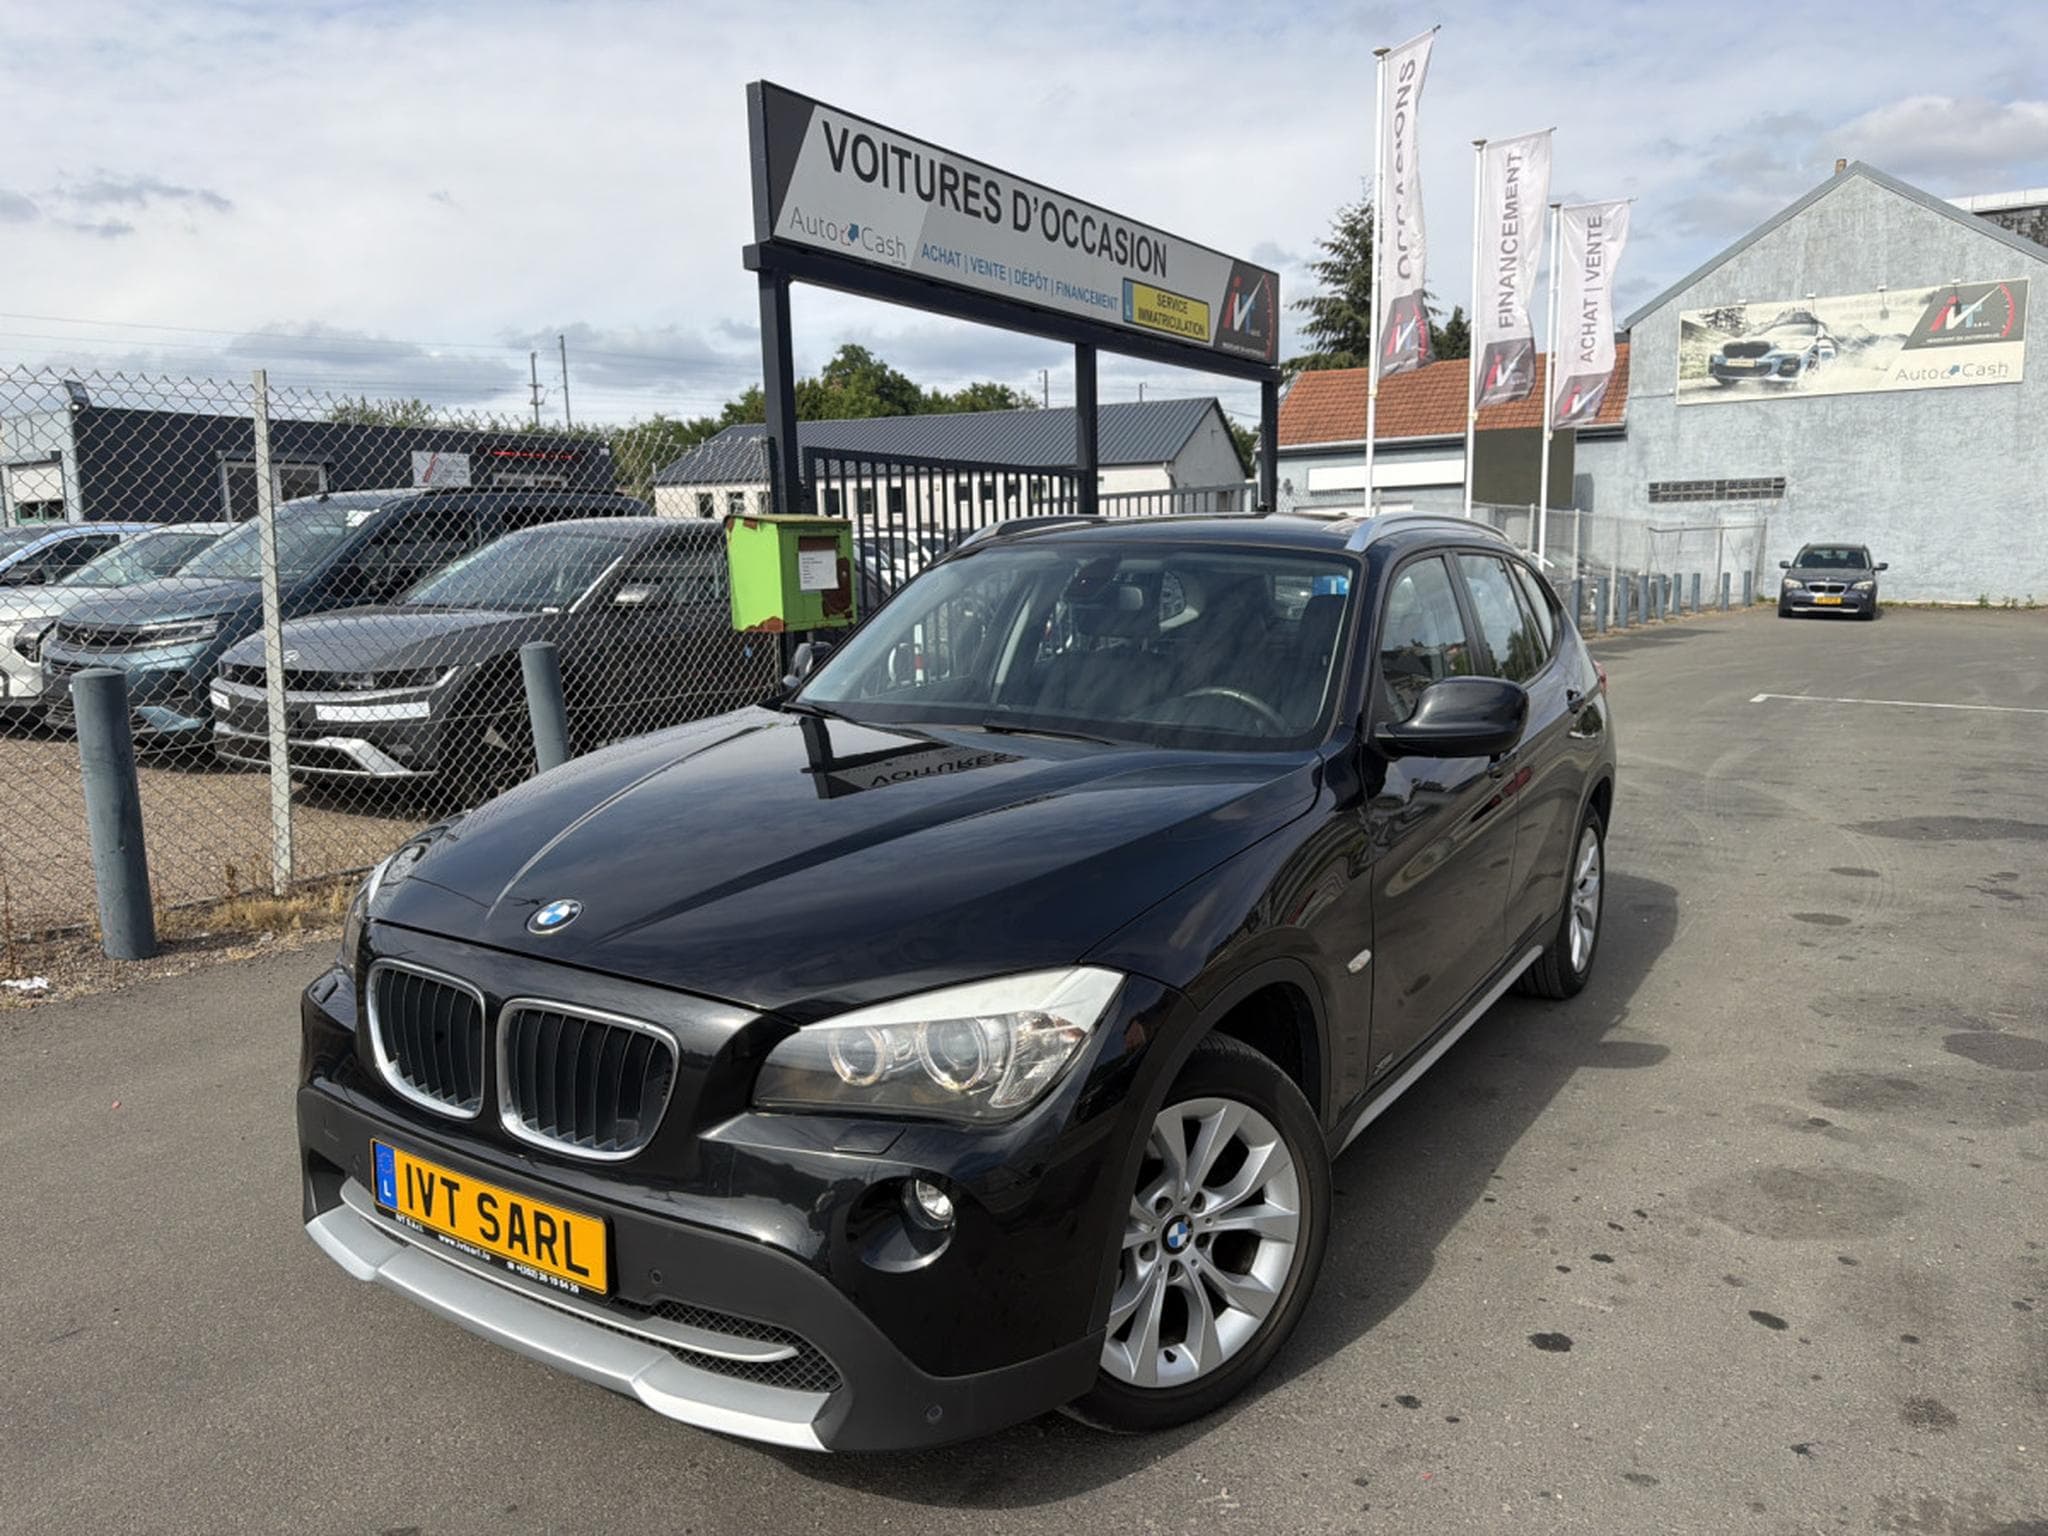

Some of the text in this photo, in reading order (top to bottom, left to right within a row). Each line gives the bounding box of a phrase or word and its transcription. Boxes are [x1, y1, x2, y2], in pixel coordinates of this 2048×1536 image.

[822, 120, 1001, 224] VOITURES
[790, 206, 907, 260] Auto Cash
[1499, 153, 1522, 328] FINANCEMENT
[921, 243, 1119, 312] ACHAT VENTE DÉPÔT FINANCEMENT
[1157, 293, 1188, 314] SERVICE
[1581, 215, 1602, 363] ACHAT VENTE
[1138, 307, 1205, 336] IMMATRICULATION
[1895, 361, 2009, 381] Auto Cash
[383, 1180, 392, 1198] L
[405, 1162, 590, 1279] IVT SARL
